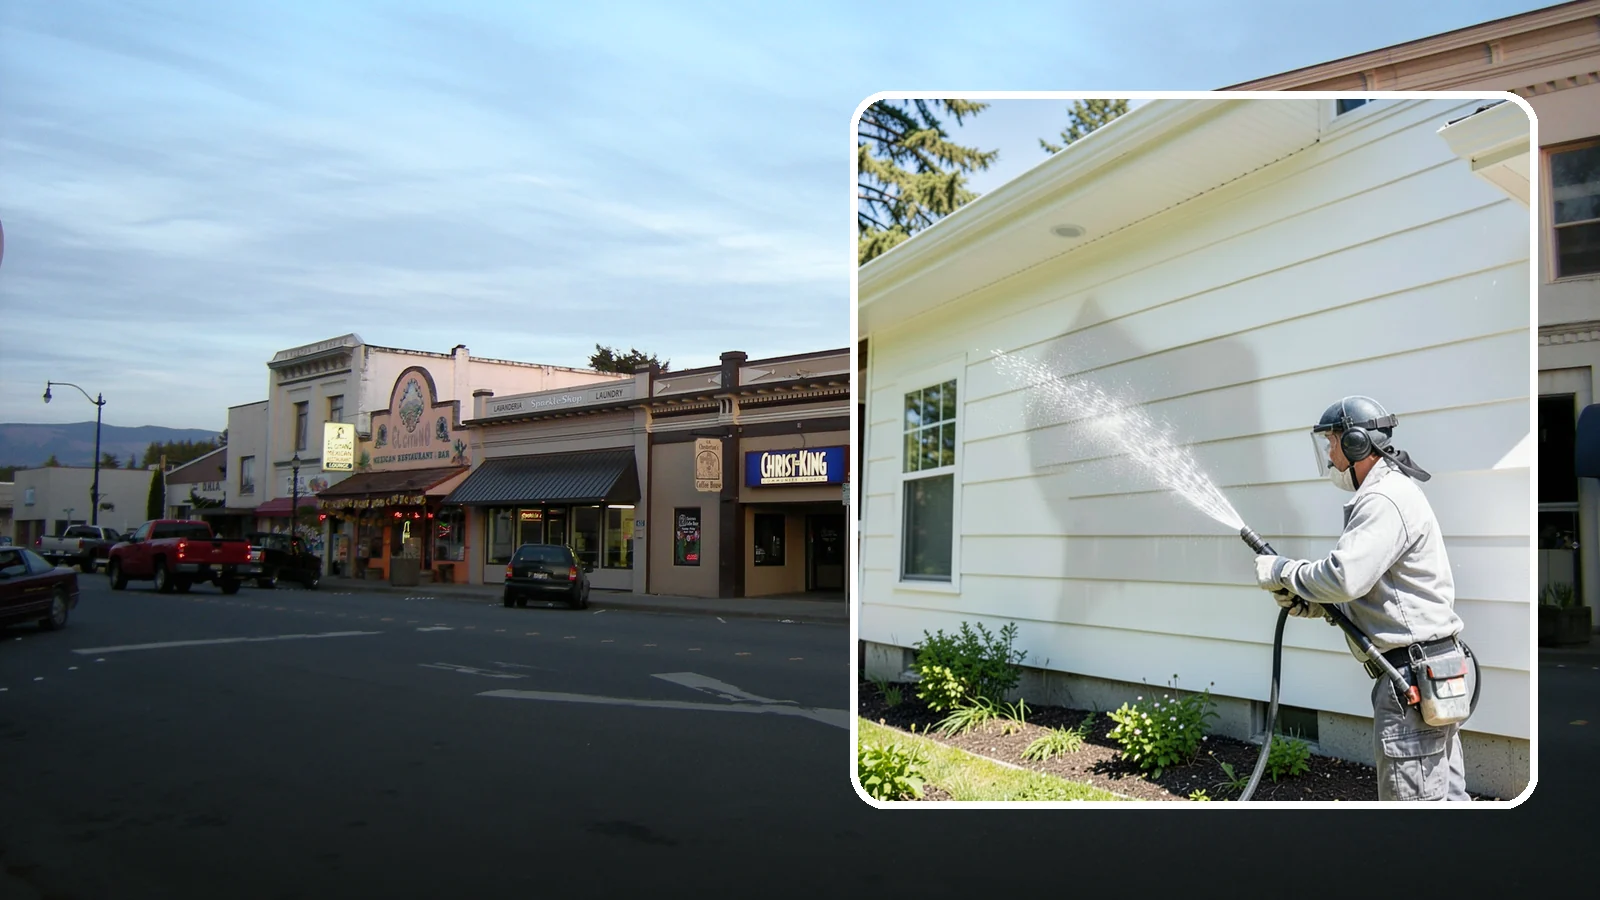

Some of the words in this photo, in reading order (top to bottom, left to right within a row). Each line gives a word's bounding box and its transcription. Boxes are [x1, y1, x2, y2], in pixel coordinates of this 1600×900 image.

[561, 394, 582, 404] Shop
[595, 389, 623, 400] LAUNDRY
[493, 402, 523, 412] LAVANDERIA
[373, 454, 396, 464] MEXICAN
[397, 451, 434, 461] RESTAURANT
[438, 450, 450, 459] BAR
[761, 452, 798, 478] CHRIST
[799, 450, 827, 476] KING
